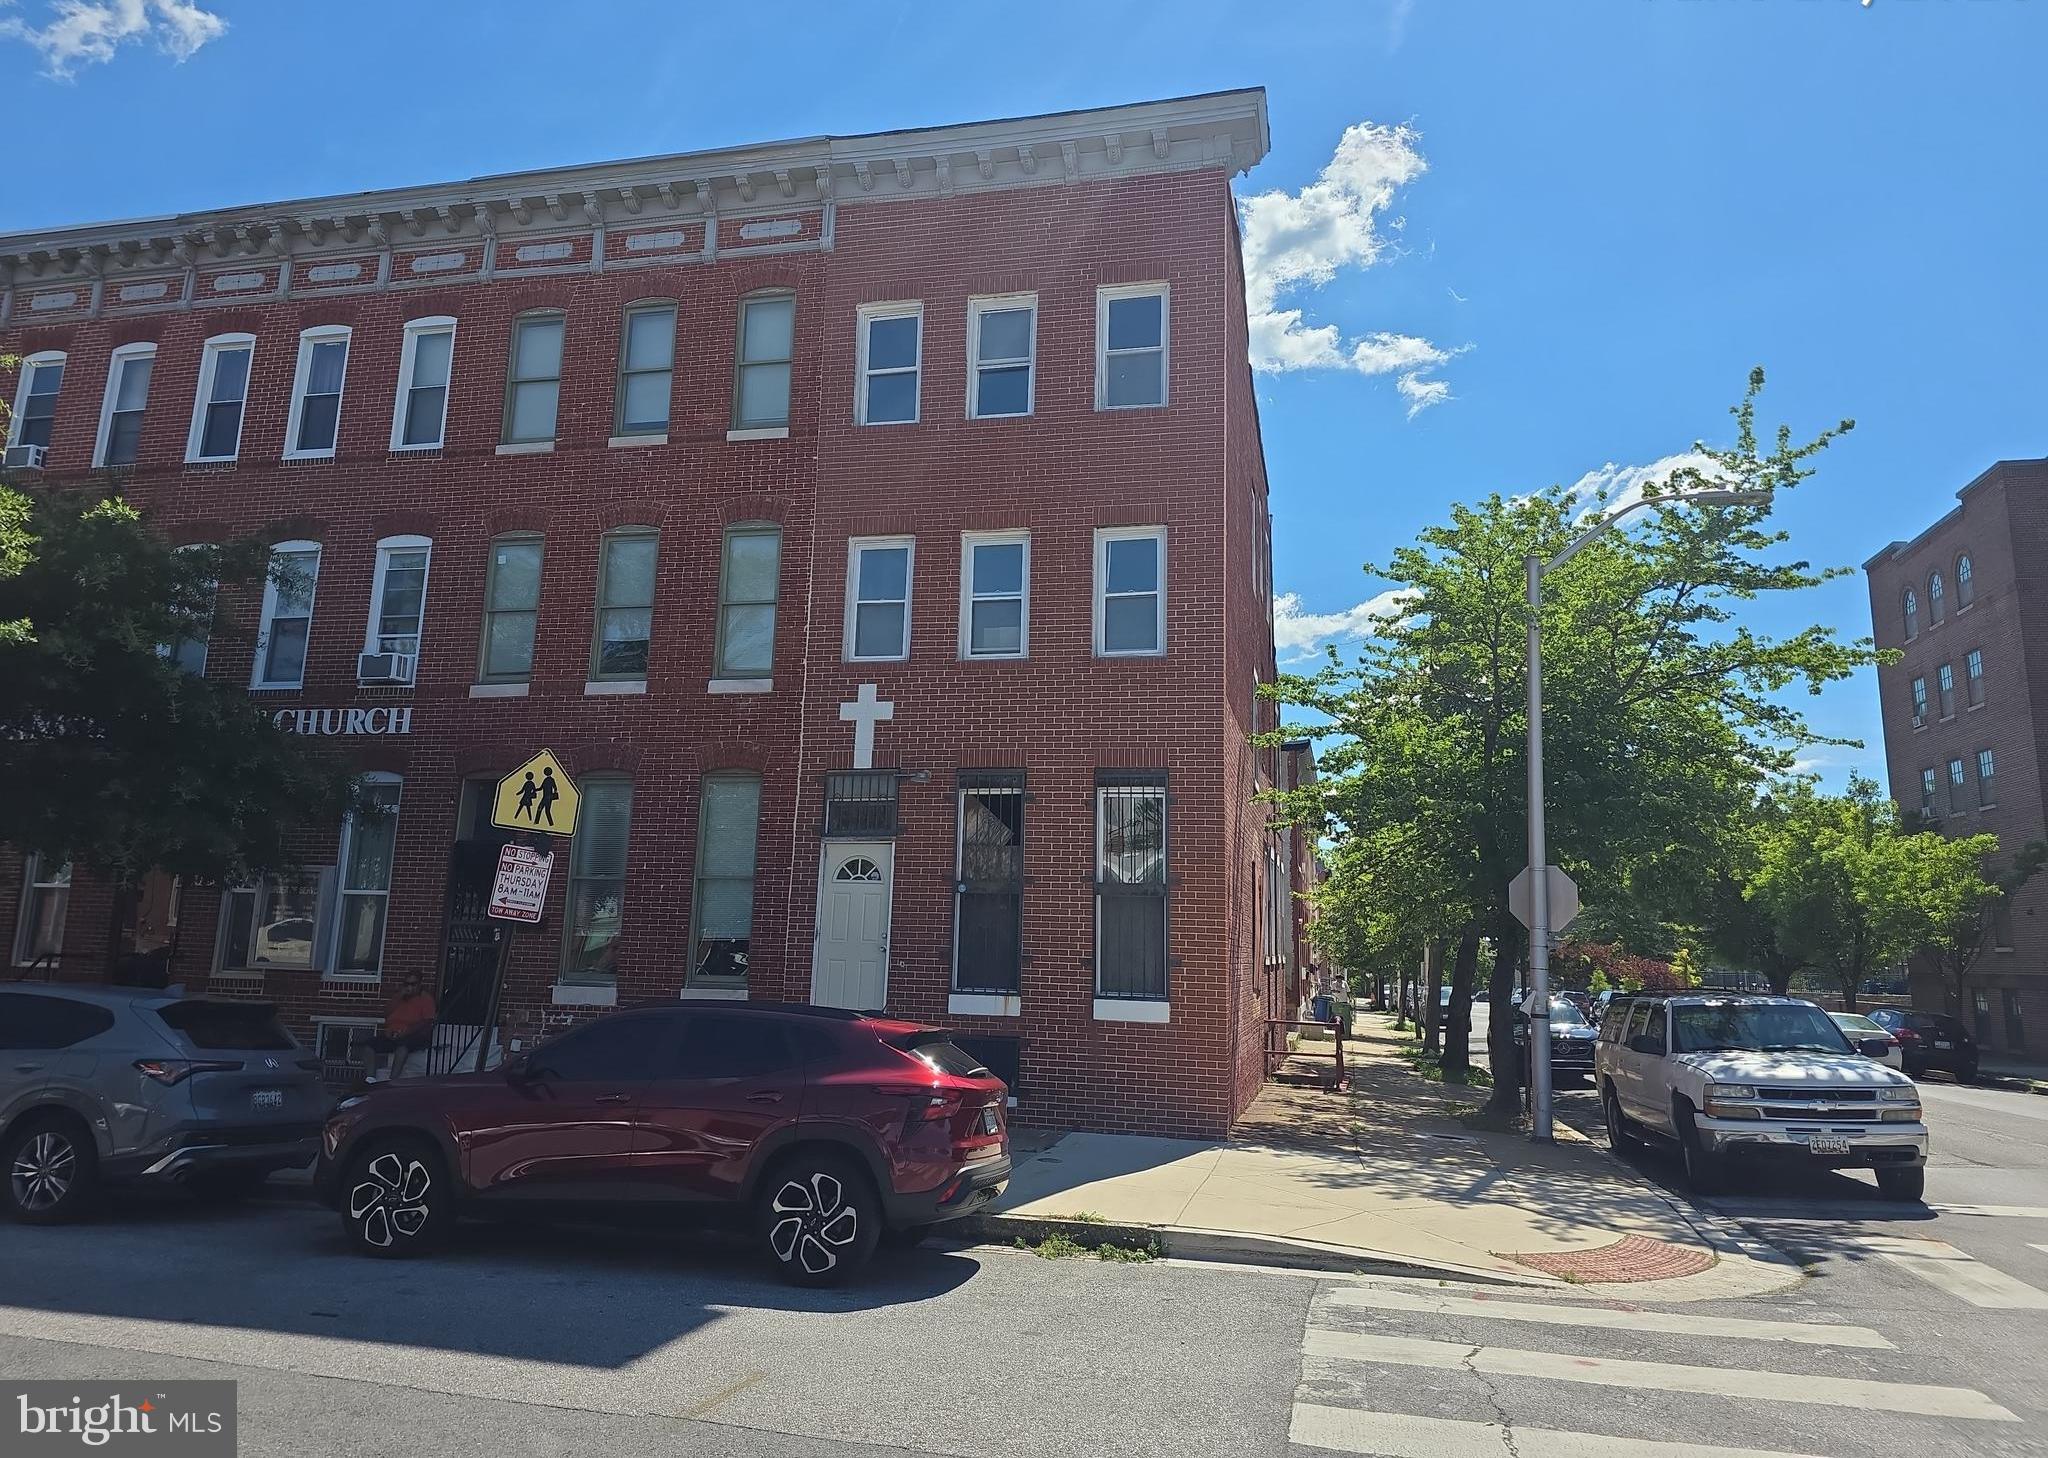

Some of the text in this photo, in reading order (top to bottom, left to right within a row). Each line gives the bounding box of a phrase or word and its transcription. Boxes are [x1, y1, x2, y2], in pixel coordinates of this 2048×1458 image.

[272, 707, 415, 735] CHURCH
[504, 847, 517, 857] NO
[501, 862, 546, 878] NO PARKING
[500, 873, 544, 889] THURSDAY
[491, 906, 537, 919] TOW AWAY ZONE
